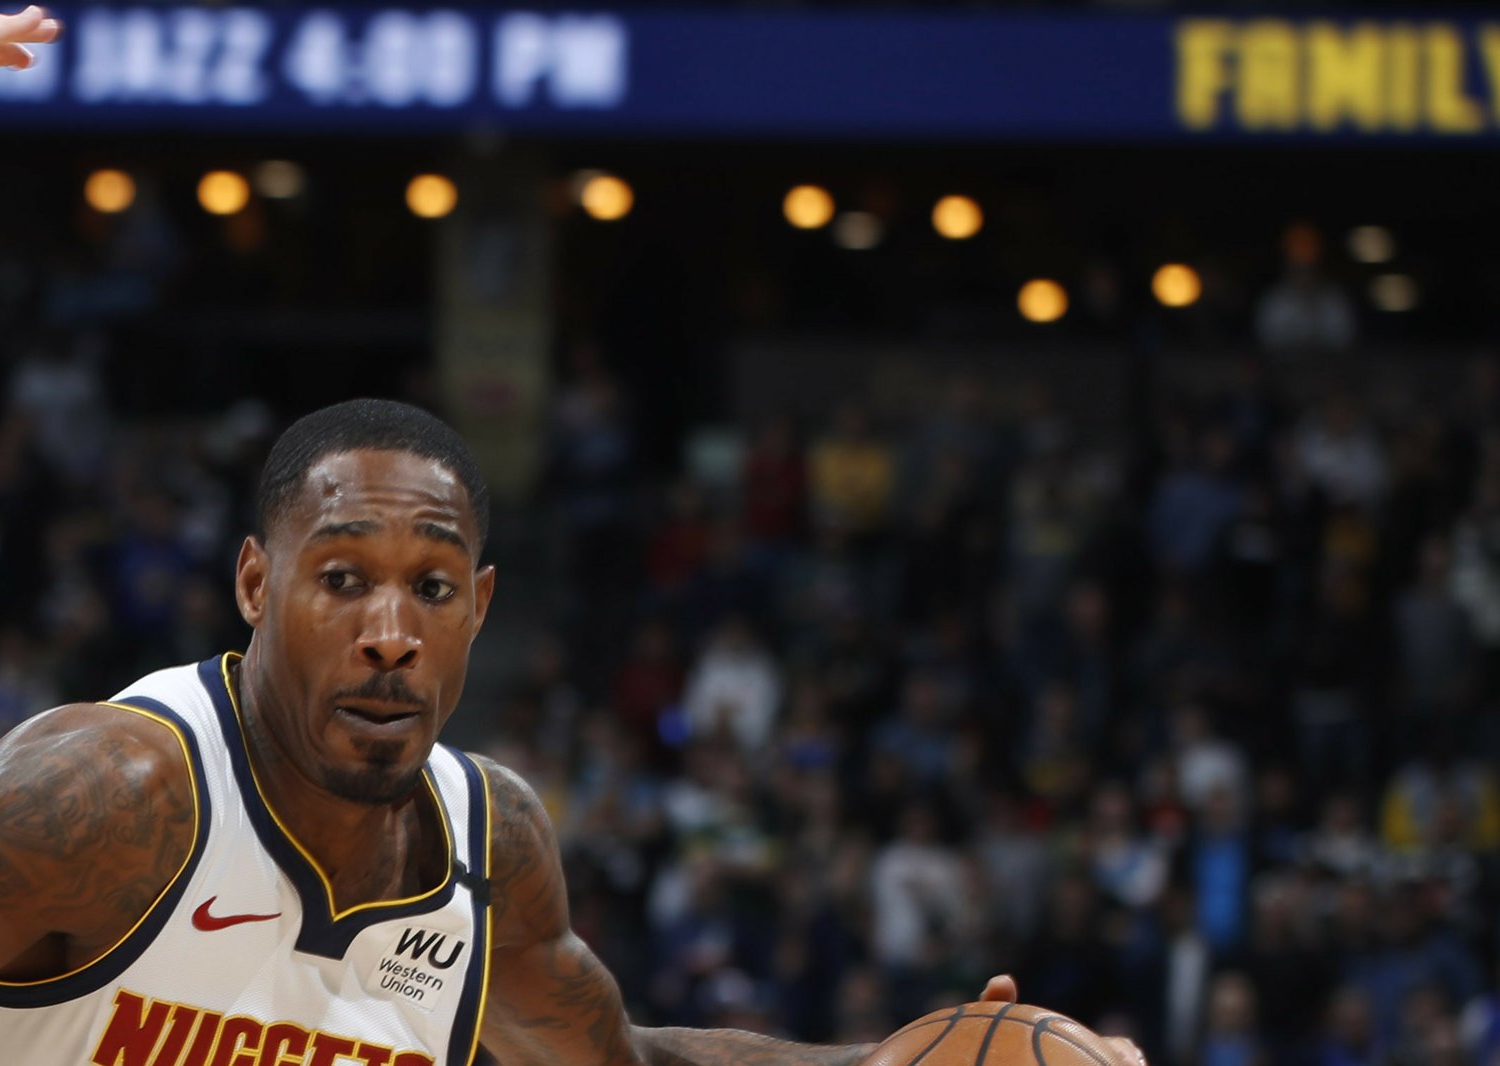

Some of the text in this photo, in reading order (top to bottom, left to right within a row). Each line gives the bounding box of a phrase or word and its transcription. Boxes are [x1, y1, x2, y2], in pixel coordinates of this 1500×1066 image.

[73, 10, 271, 104] JAZZ
[491, 10, 626, 110] PM
[394, 927, 465, 970] WU
[379, 957, 444, 991] Western
[380, 974, 425, 1001] Union
